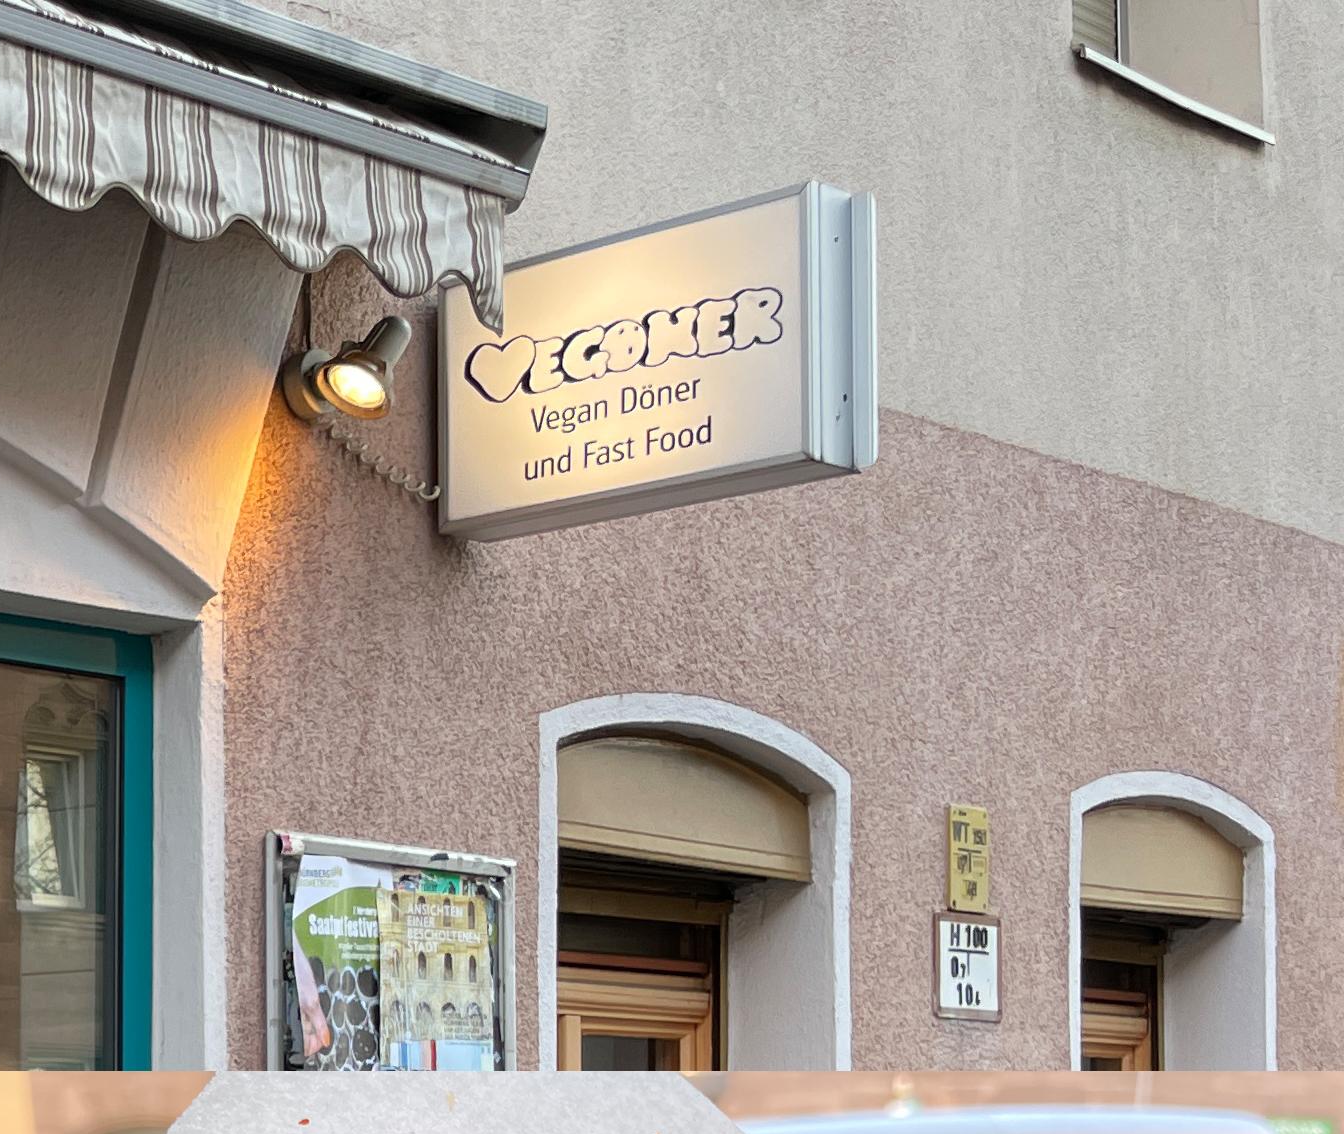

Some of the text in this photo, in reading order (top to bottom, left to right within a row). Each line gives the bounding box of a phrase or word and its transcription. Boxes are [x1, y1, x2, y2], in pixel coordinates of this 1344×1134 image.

[530, 377, 701, 434] Vegan Döner
[523, 415, 713, 481] und Fast Food
[308, 913, 379, 939] Saatgutfestiva
[950, 923, 988, 949] H 100
